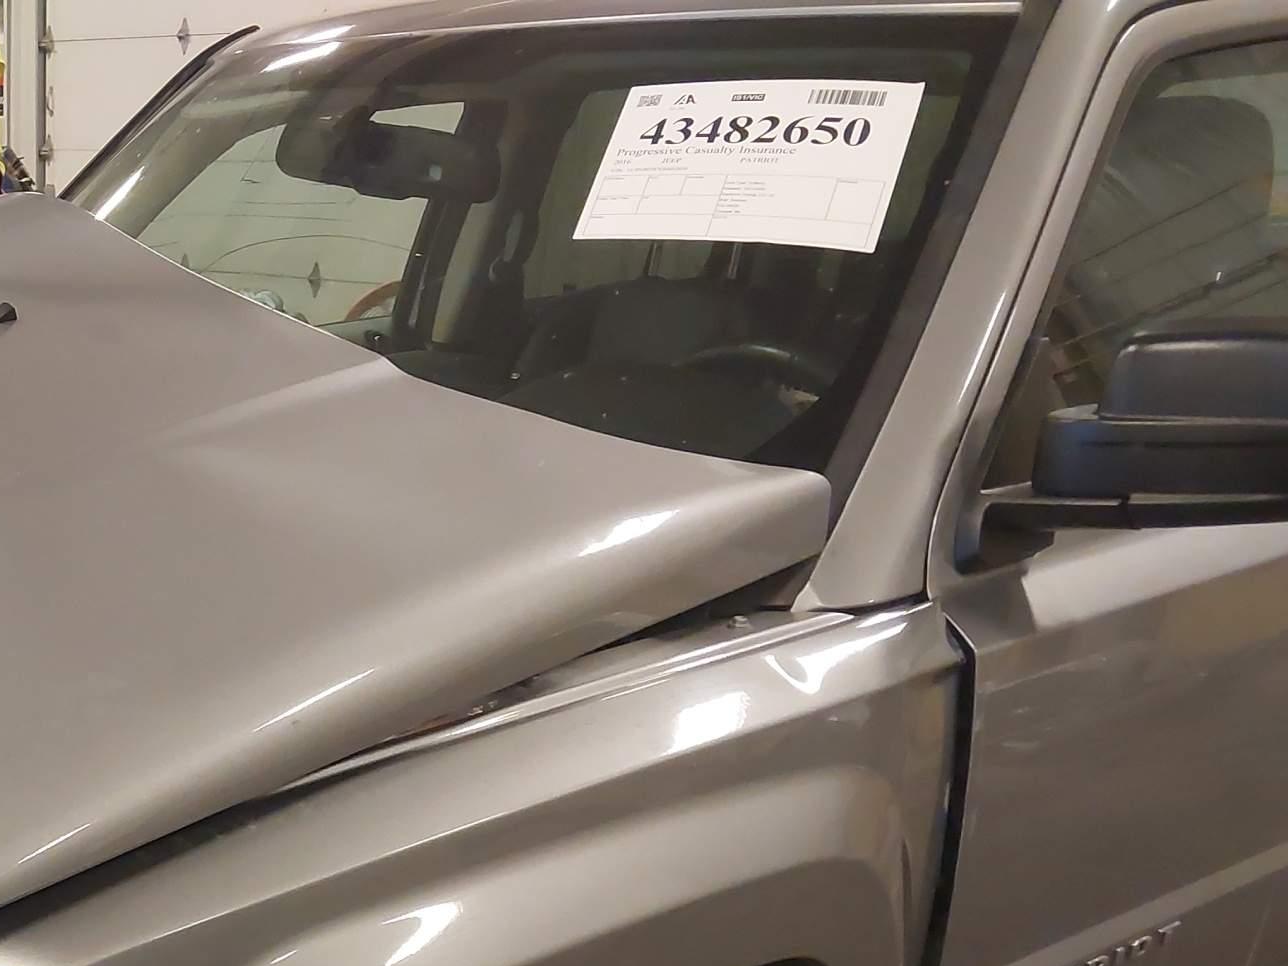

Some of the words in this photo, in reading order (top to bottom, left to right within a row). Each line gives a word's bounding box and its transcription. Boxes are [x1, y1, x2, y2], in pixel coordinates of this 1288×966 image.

[639, 115, 871, 147] 43482650
[616, 148, 683, 158] Progressive
[685, 146, 735, 156] Casualty
[738, 146, 797, 155] Insurance
